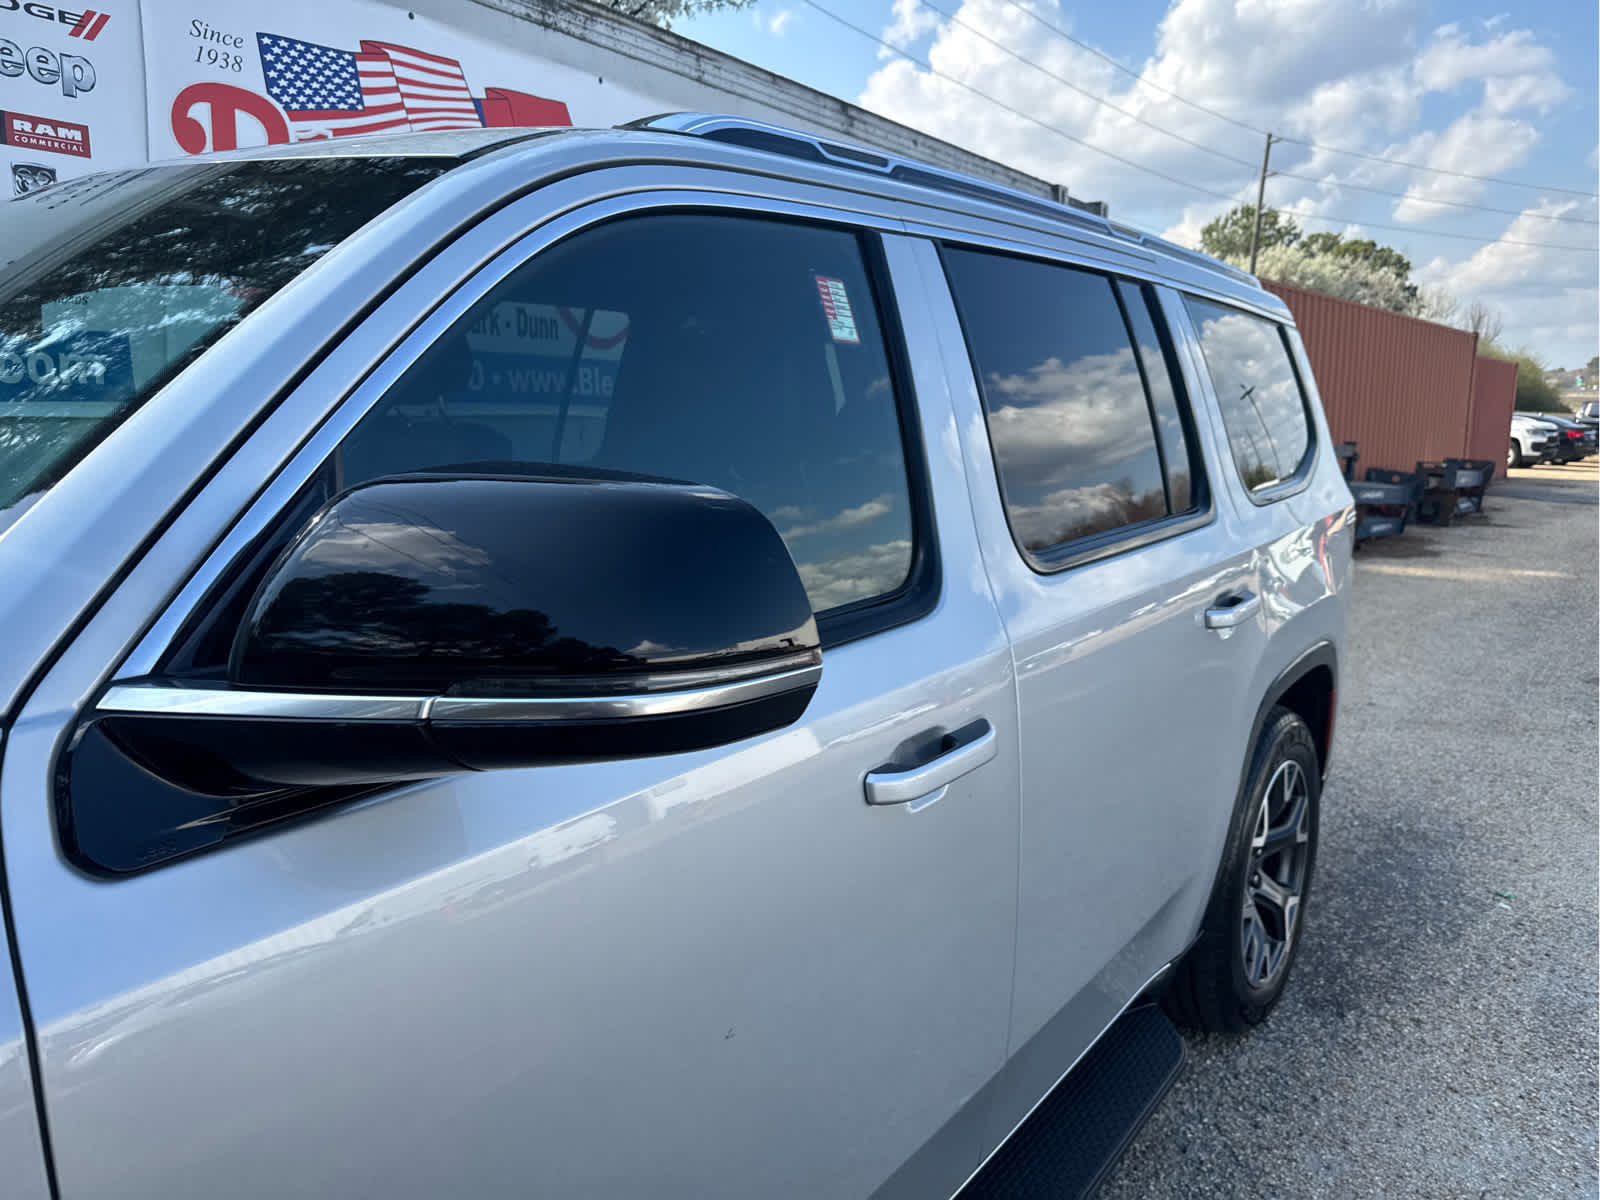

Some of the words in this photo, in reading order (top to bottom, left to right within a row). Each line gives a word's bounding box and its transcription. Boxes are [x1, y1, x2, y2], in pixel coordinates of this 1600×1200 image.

[190, 19, 244, 49] Since
[195, 46, 243, 72] 1938
[12, 119, 82, 141] RAM
[14, 135, 84, 152] COMMERCIAL
[515, 307, 559, 340] Dunn
